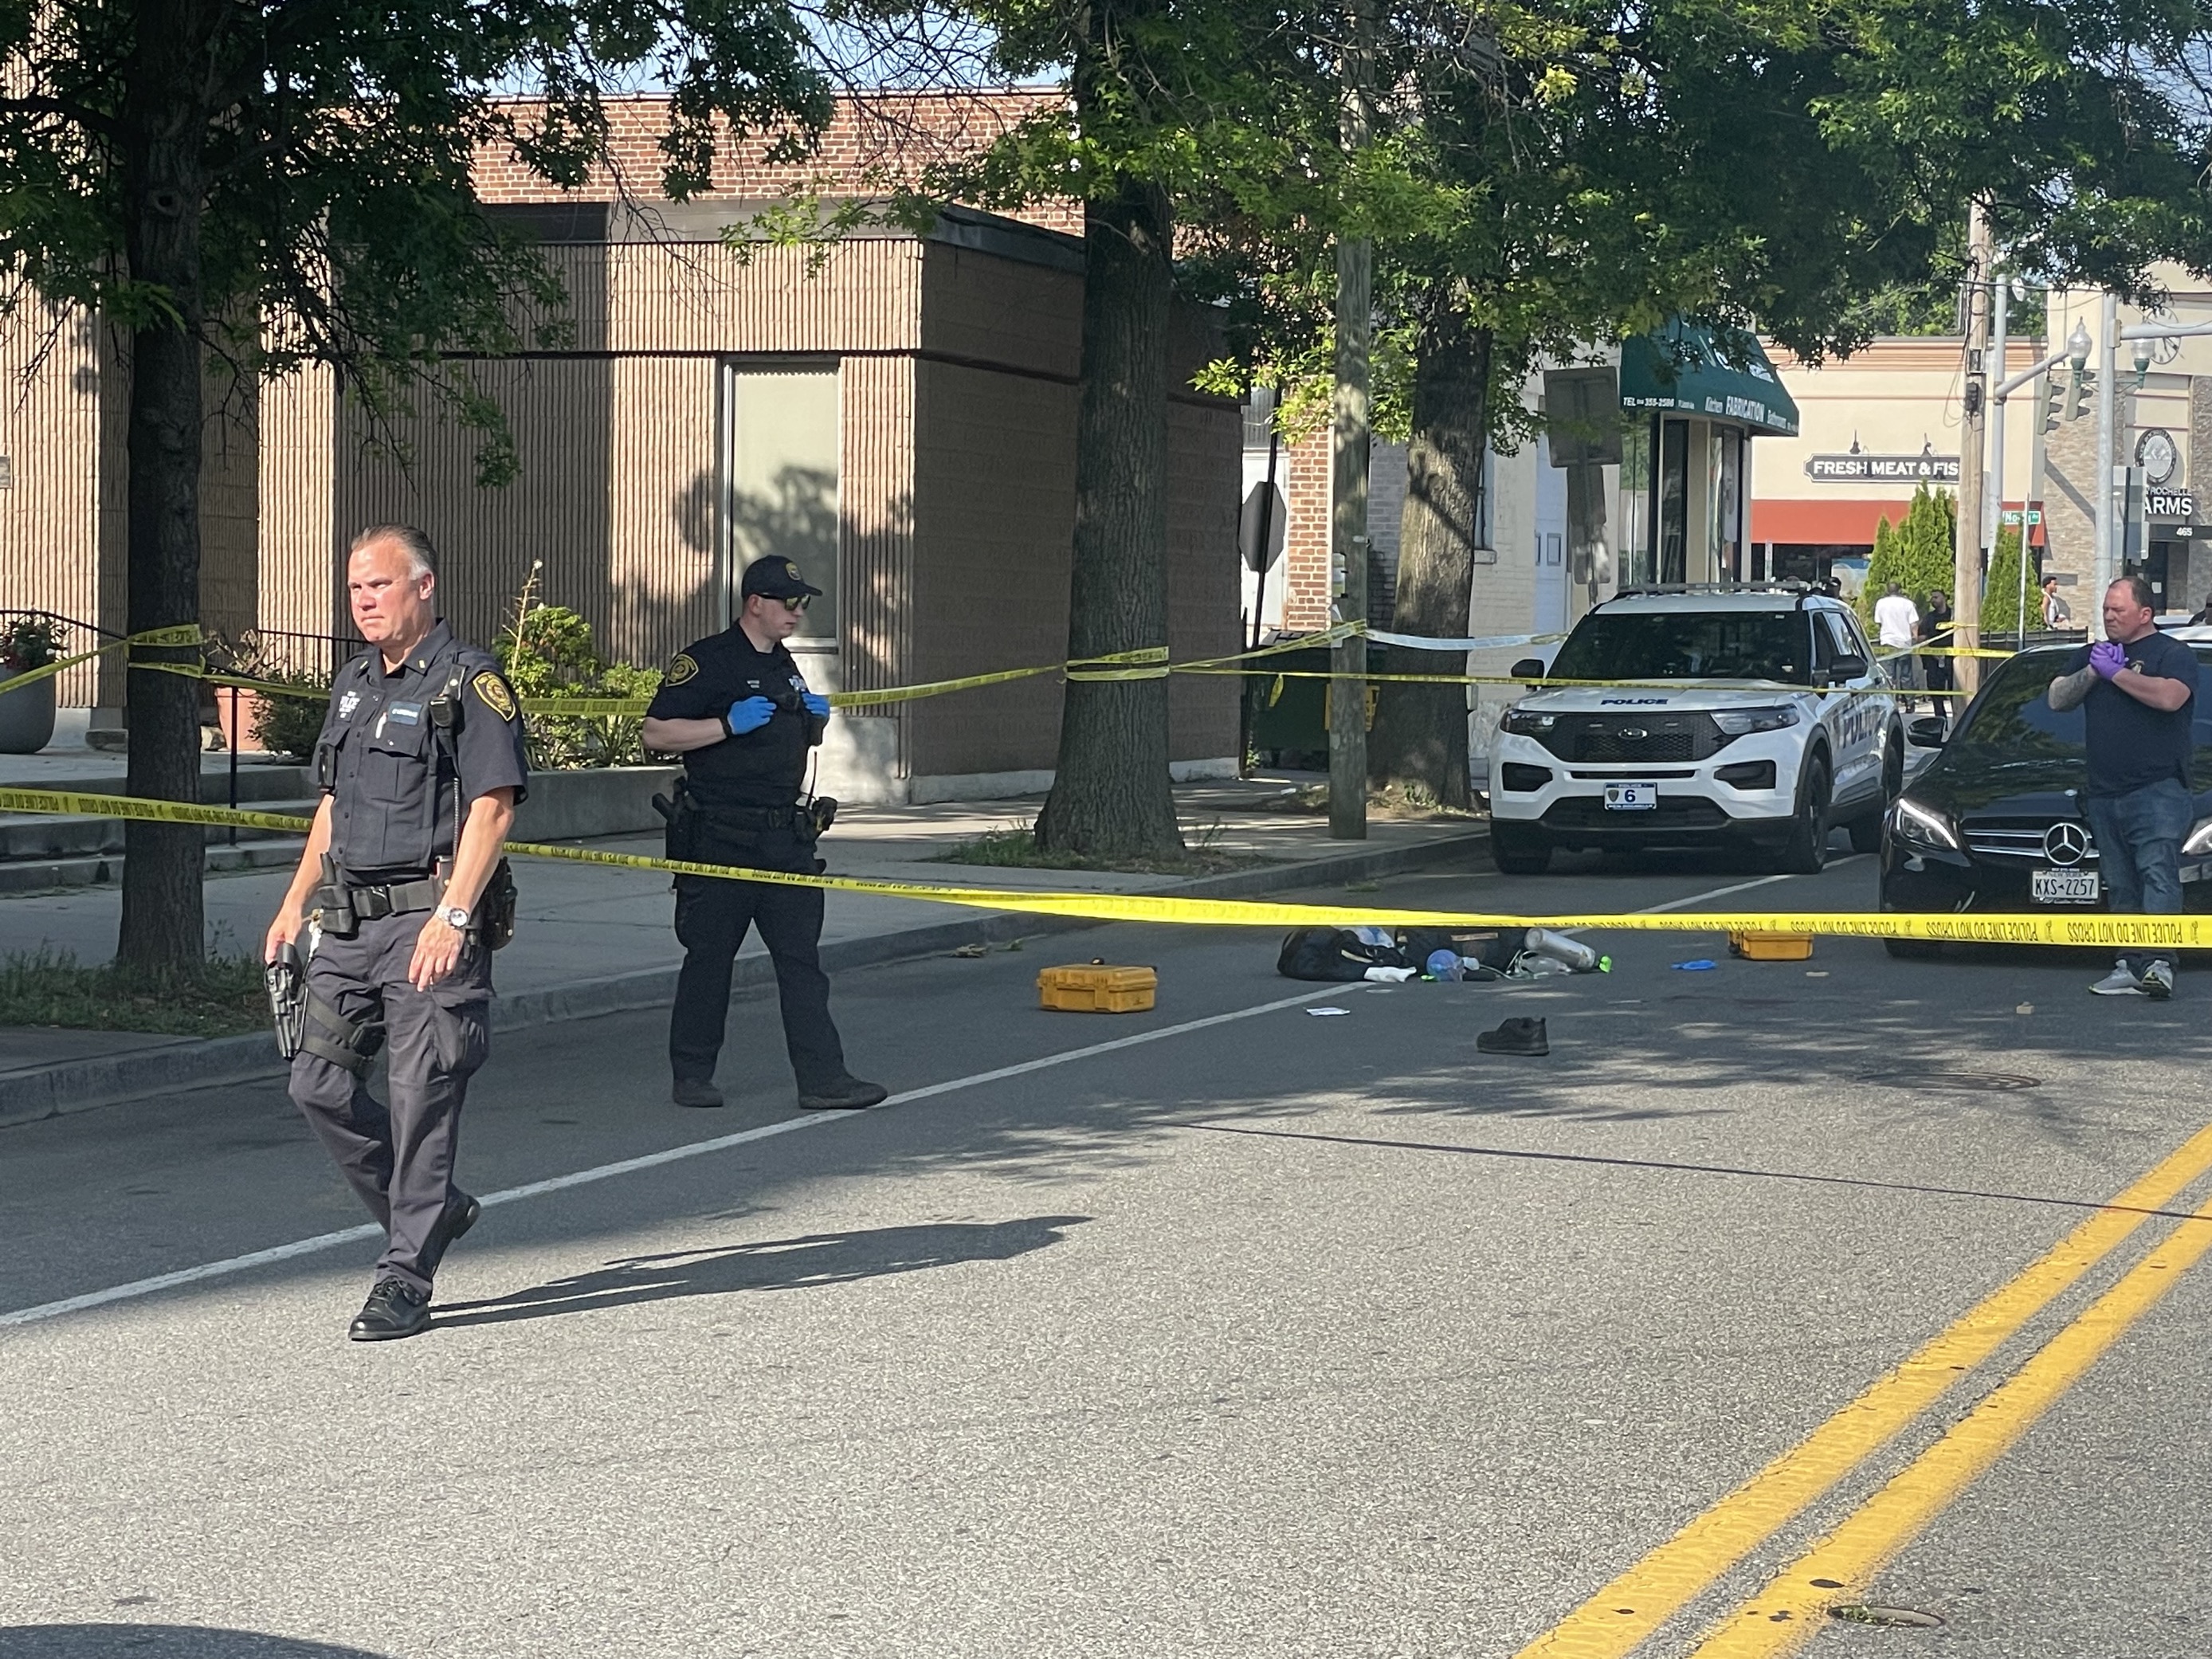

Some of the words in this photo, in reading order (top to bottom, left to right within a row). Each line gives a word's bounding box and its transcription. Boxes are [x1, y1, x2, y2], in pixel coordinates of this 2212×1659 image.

[1814, 461, 1868, 475] FRESH
[1872, 462, 1916, 476] MEAT
[1919, 462, 1931, 476] &
[1933, 462, 1959, 476] FIS
[2151, 486, 2192, 496] ROCHELLE
[1624, 789, 1636, 803] 6
[1925, 921, 1955, 939] CROSS
[1956, 922, 1975, 939] NOT
[1974, 922, 1989, 940] DO
[1987, 922, 2009, 940] LINE
[2007, 922, 2039, 942] POLICE
[2067, 922, 2096, 943] CROSS
[2098, 922, 2116, 943] NOT
[2116, 922, 2130, 943] DO
[2131, 923, 2151, 943] LINE
[2152, 923, 2183, 943] POLICE
